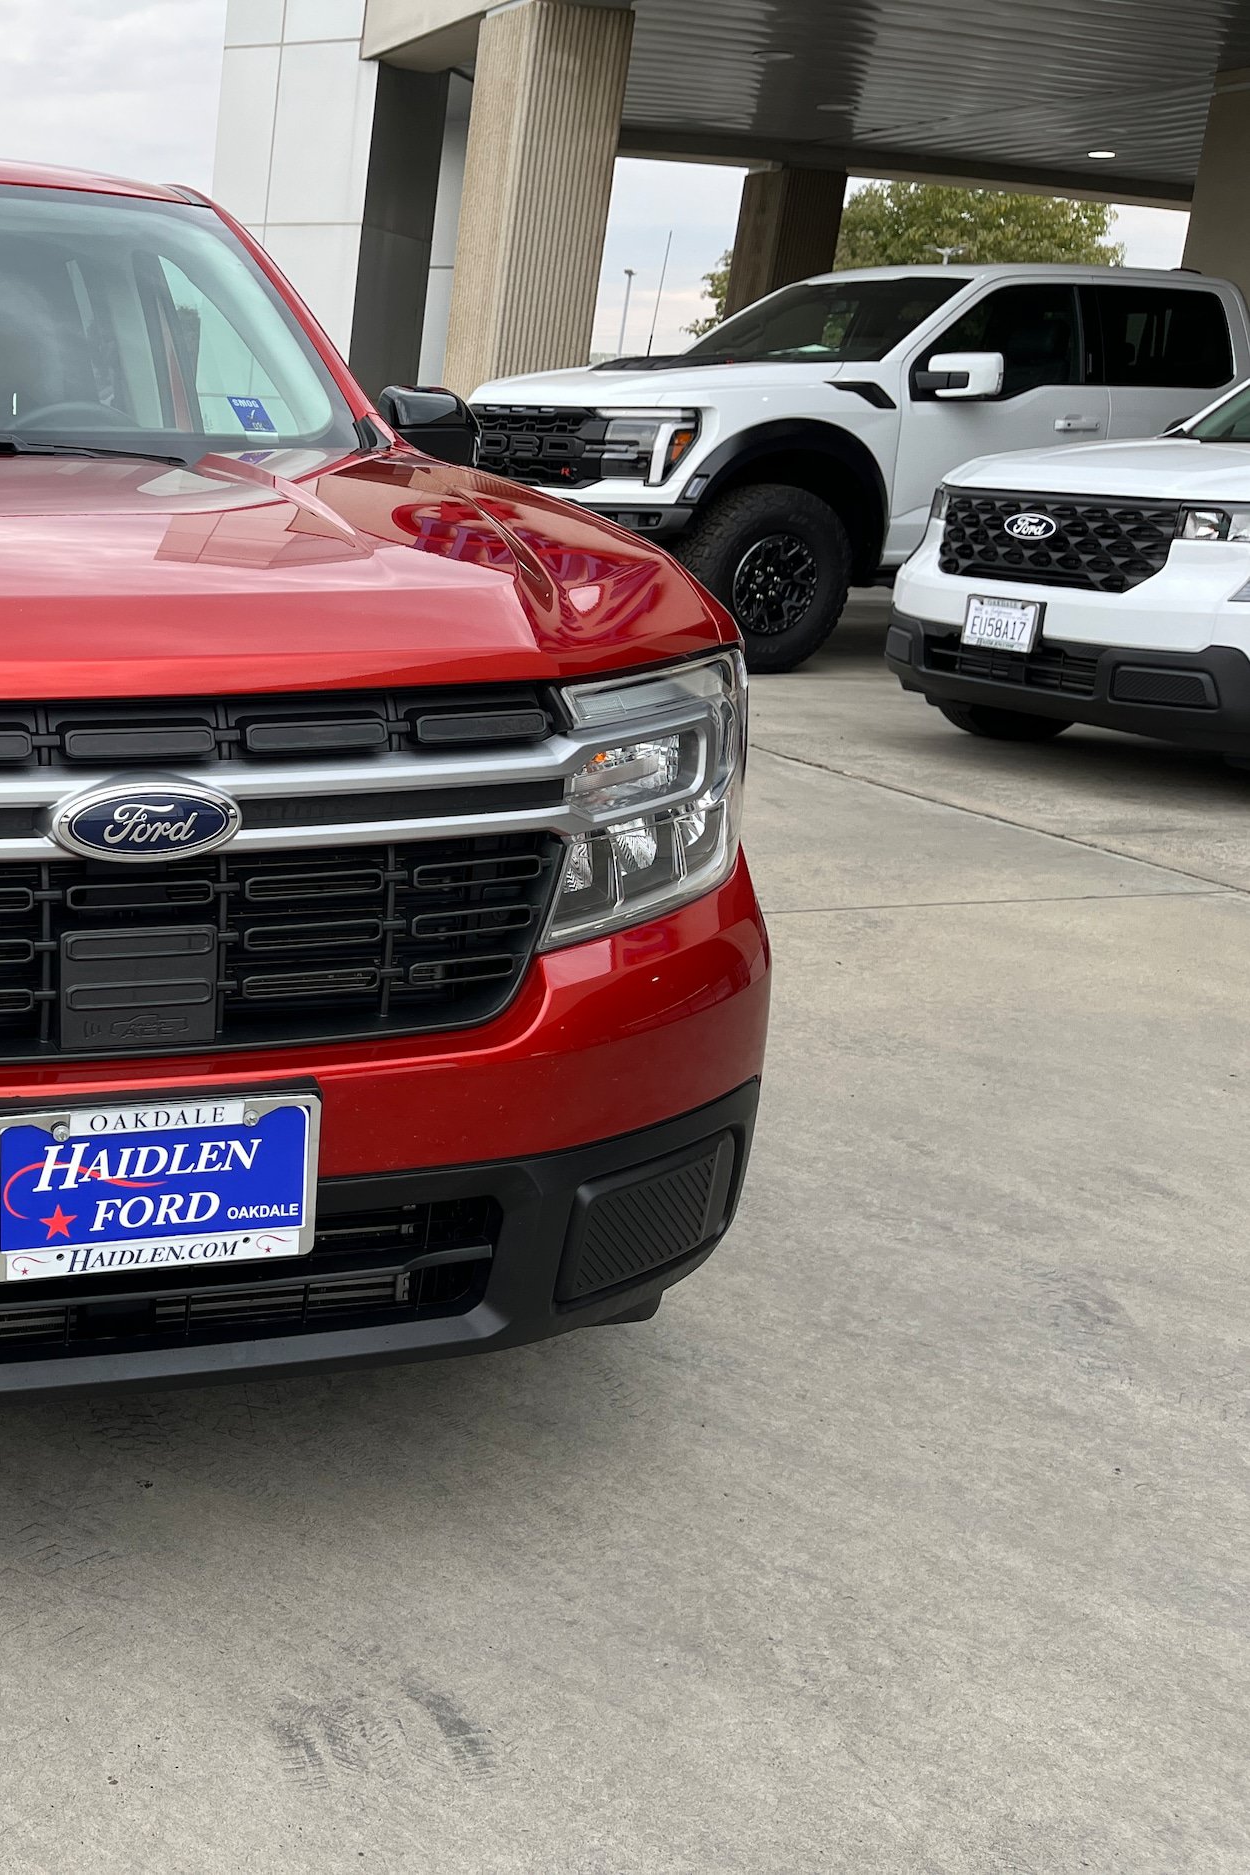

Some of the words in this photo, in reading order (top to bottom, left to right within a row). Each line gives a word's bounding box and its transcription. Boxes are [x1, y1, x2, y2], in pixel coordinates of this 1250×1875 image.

[232, 398, 259, 408] SMOG
[1013, 516, 1047, 536] Ford
[970, 615, 1027, 642] EU58A17
[103, 803, 198, 844] Ford
[89, 1106, 225, 1132] OAKDALE
[32, 1138, 262, 1193] HAIDLEN
[89, 1191, 220, 1232] FORD
[226, 1203, 299, 1221] OAKDALE
[67, 1240, 240, 1273] HAIDLEN.COM
